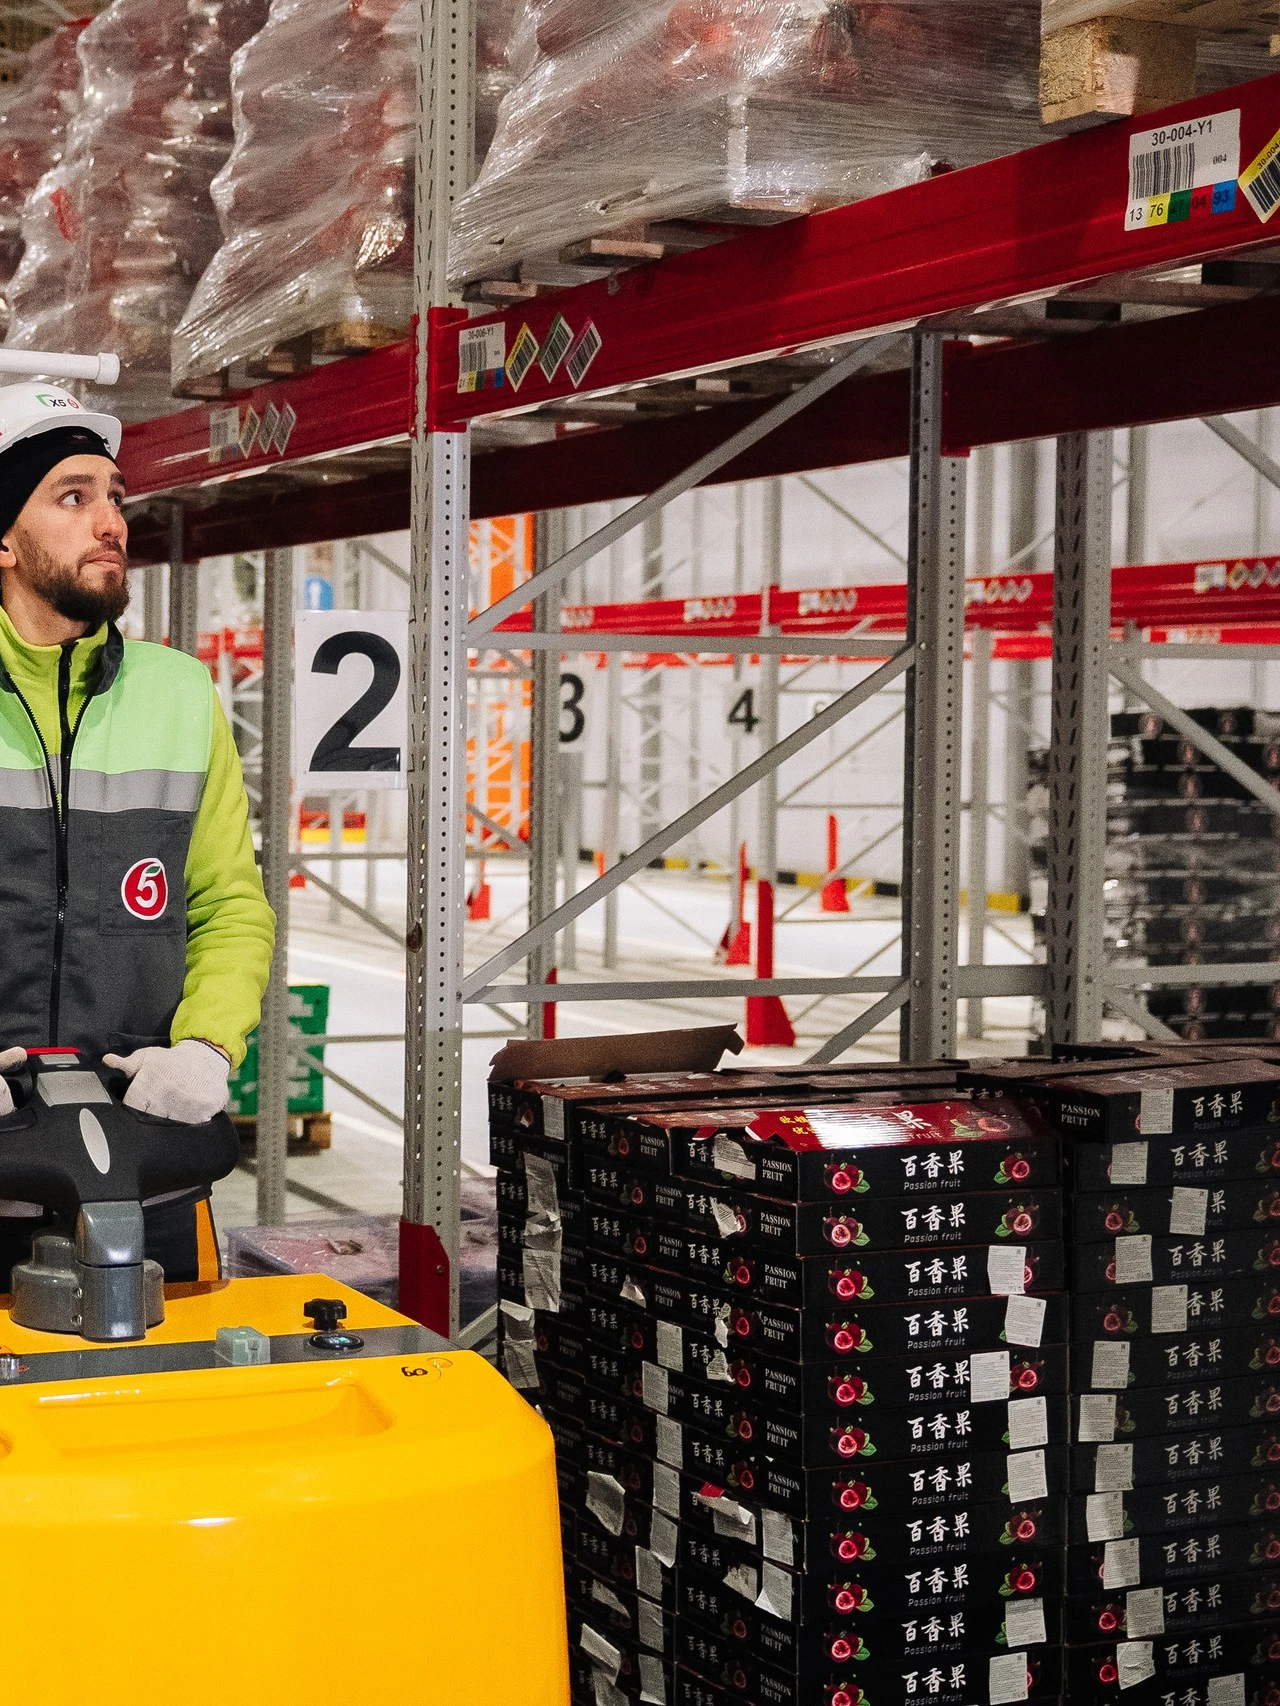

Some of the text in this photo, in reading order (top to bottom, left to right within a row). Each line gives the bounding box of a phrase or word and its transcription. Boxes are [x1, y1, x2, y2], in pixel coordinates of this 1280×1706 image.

[1151, 119, 1213, 146] 30-004-Y1
[1213, 153, 1228, 165] 004
[1129, 207, 1143, 222] 13
[1150, 203, 1164, 218] 76
[1192, 195, 1207, 210] 04
[49, 399, 67, 407] X5
[307, 630, 401, 773] 2
[559, 672, 585, 743] 3
[728, 688, 760, 733] 4
[1061, 1103, 1101, 1119] PASSION
[1192, 1090, 1243, 1118] 百香果
[580, 1121, 606, 1139] 百香果
[1061, 1114, 1088, 1127] FRUIT
[640, 1135, 665, 1148] PASSION
[640, 1145, 658, 1157] FRUIT
[1170, 1140, 1228, 1167] 百香果
[762, 1158, 792, 1173] PASSION
[901, 1150, 964, 1178] 百香果
[590, 1169, 618, 1188] 百香果
[762, 1170, 784, 1182] FRUIT
[904, 1179, 961, 1190] Passion fruit
[656, 1184, 682, 1198] PASSION
[656, 1194, 675, 1206] FRUIT
[760, 1212, 790, 1228] PASSION
[901, 1202, 966, 1231] 百香果
[592, 1217, 620, 1237] 百香果
[760, 1223, 782, 1236] FRUIT
[659, 1234, 682, 1248] PASSIO
[904, 1232, 962, 1243] Passion fruit
[659, 1244, 679, 1258] FRUIT
[688, 1243, 720, 1266] 百香果
[1168, 1240, 1226, 1267] 百香果
[590, 1264, 619, 1284] 百香果
[765, 1264, 797, 1280] PASSION
[904, 1255, 968, 1284] 百香果
[765, 1274, 788, 1289] FRUIT
[908, 1285, 964, 1296] Passion fruit
[655, 1284, 680, 1299] PASSION
[655, 1295, 673, 1307] FRUIT
[689, 1294, 721, 1317] 百香果
[1187, 1289, 1224, 1316] 香果
[590, 1308, 618, 1330] 百香果
[763, 1316, 794, 1333] PASSION
[904, 1308, 969, 1336] 百香果
[763, 1327, 785, 1341] FRUIT
[907, 1338, 965, 1350] Passion fruit
[1164, 1339, 1222, 1367] 百香果
[590, 1355, 618, 1378] 百香果
[905, 1360, 970, 1388] 百香果
[765, 1368, 796, 1386] PASSION
[765, 1379, 787, 1394] FRUIT
[908, 1390, 967, 1401] Passion fruit
[1164, 1387, 1222, 1415] 百香果
[589, 1399, 617, 1422] 百香果
[691, 1393, 724, 1418] 百香果
[766, 1421, 798, 1439] PASSION
[907, 1410, 972, 1440] 百香果
[766, 1433, 789, 1447] FRUIT
[910, 1440, 968, 1453] Passion fruit
[692, 1442, 724, 1467] 百香果
[1165, 1437, 1223, 1465] 百香果
[768, 1471, 800, 1490] PASSION
[909, 1462, 972, 1492] 百香果
[768, 1483, 790, 1498] FRUIT
[912, 1492, 969, 1505] Passion fruit
[1163, 1486, 1221, 1514] 百香果
[906, 1512, 971, 1542] 百香果
[688, 1540, 720, 1567] 百香果
[910, 1542, 967, 1556] Passion fruit
[1163, 1534, 1221, 1563] 百香果
[904, 1564, 970, 1594] 百香果
[686, 1587, 718, 1614] 百香果
[908, 1593, 965, 1607] Passion fruit
[1163, 1584, 1222, 1613] 百香果
[901, 1612, 966, 1642] 百香果
[687, 1635, 718, 1663] 百香果
[904, 1642, 961, 1656] Passion fruit
[1164, 1635, 1223, 1665] 百香果
[901, 1663, 967, 1694] 百香果
[904, 1694, 962, 1706] Passion fruit
